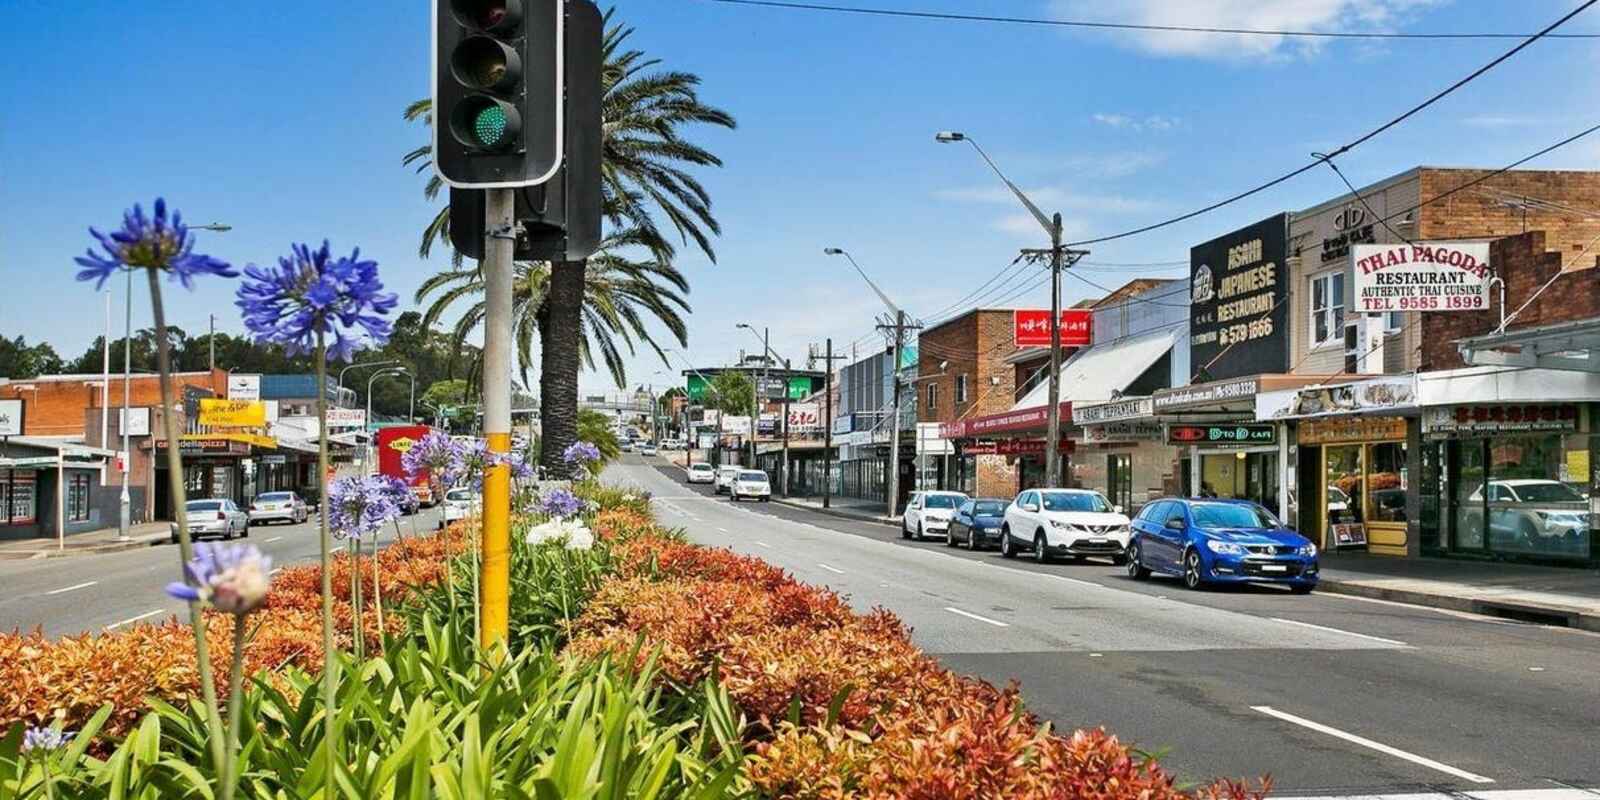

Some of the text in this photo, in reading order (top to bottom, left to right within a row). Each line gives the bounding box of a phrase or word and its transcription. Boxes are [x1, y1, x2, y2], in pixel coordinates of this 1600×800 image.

[1228, 239, 1263, 270] ASAHI
[1357, 247, 1408, 275] THAI
[1412, 246, 1489, 279] PAGODA
[1217, 262, 1276, 299] JAPANESE
[1376, 272, 1466, 285] RESTAURANT
[1361, 284, 1482, 297] AUTHENTIC THAI CUISINE
[1217, 291, 1276, 322] RESTAURANT
[1362, 296, 1483, 310] TEL 9585 1899
[1229, 323, 1248, 343] 579
[1209, 427, 1222, 440] D
[1236, 427, 1248, 440] D
